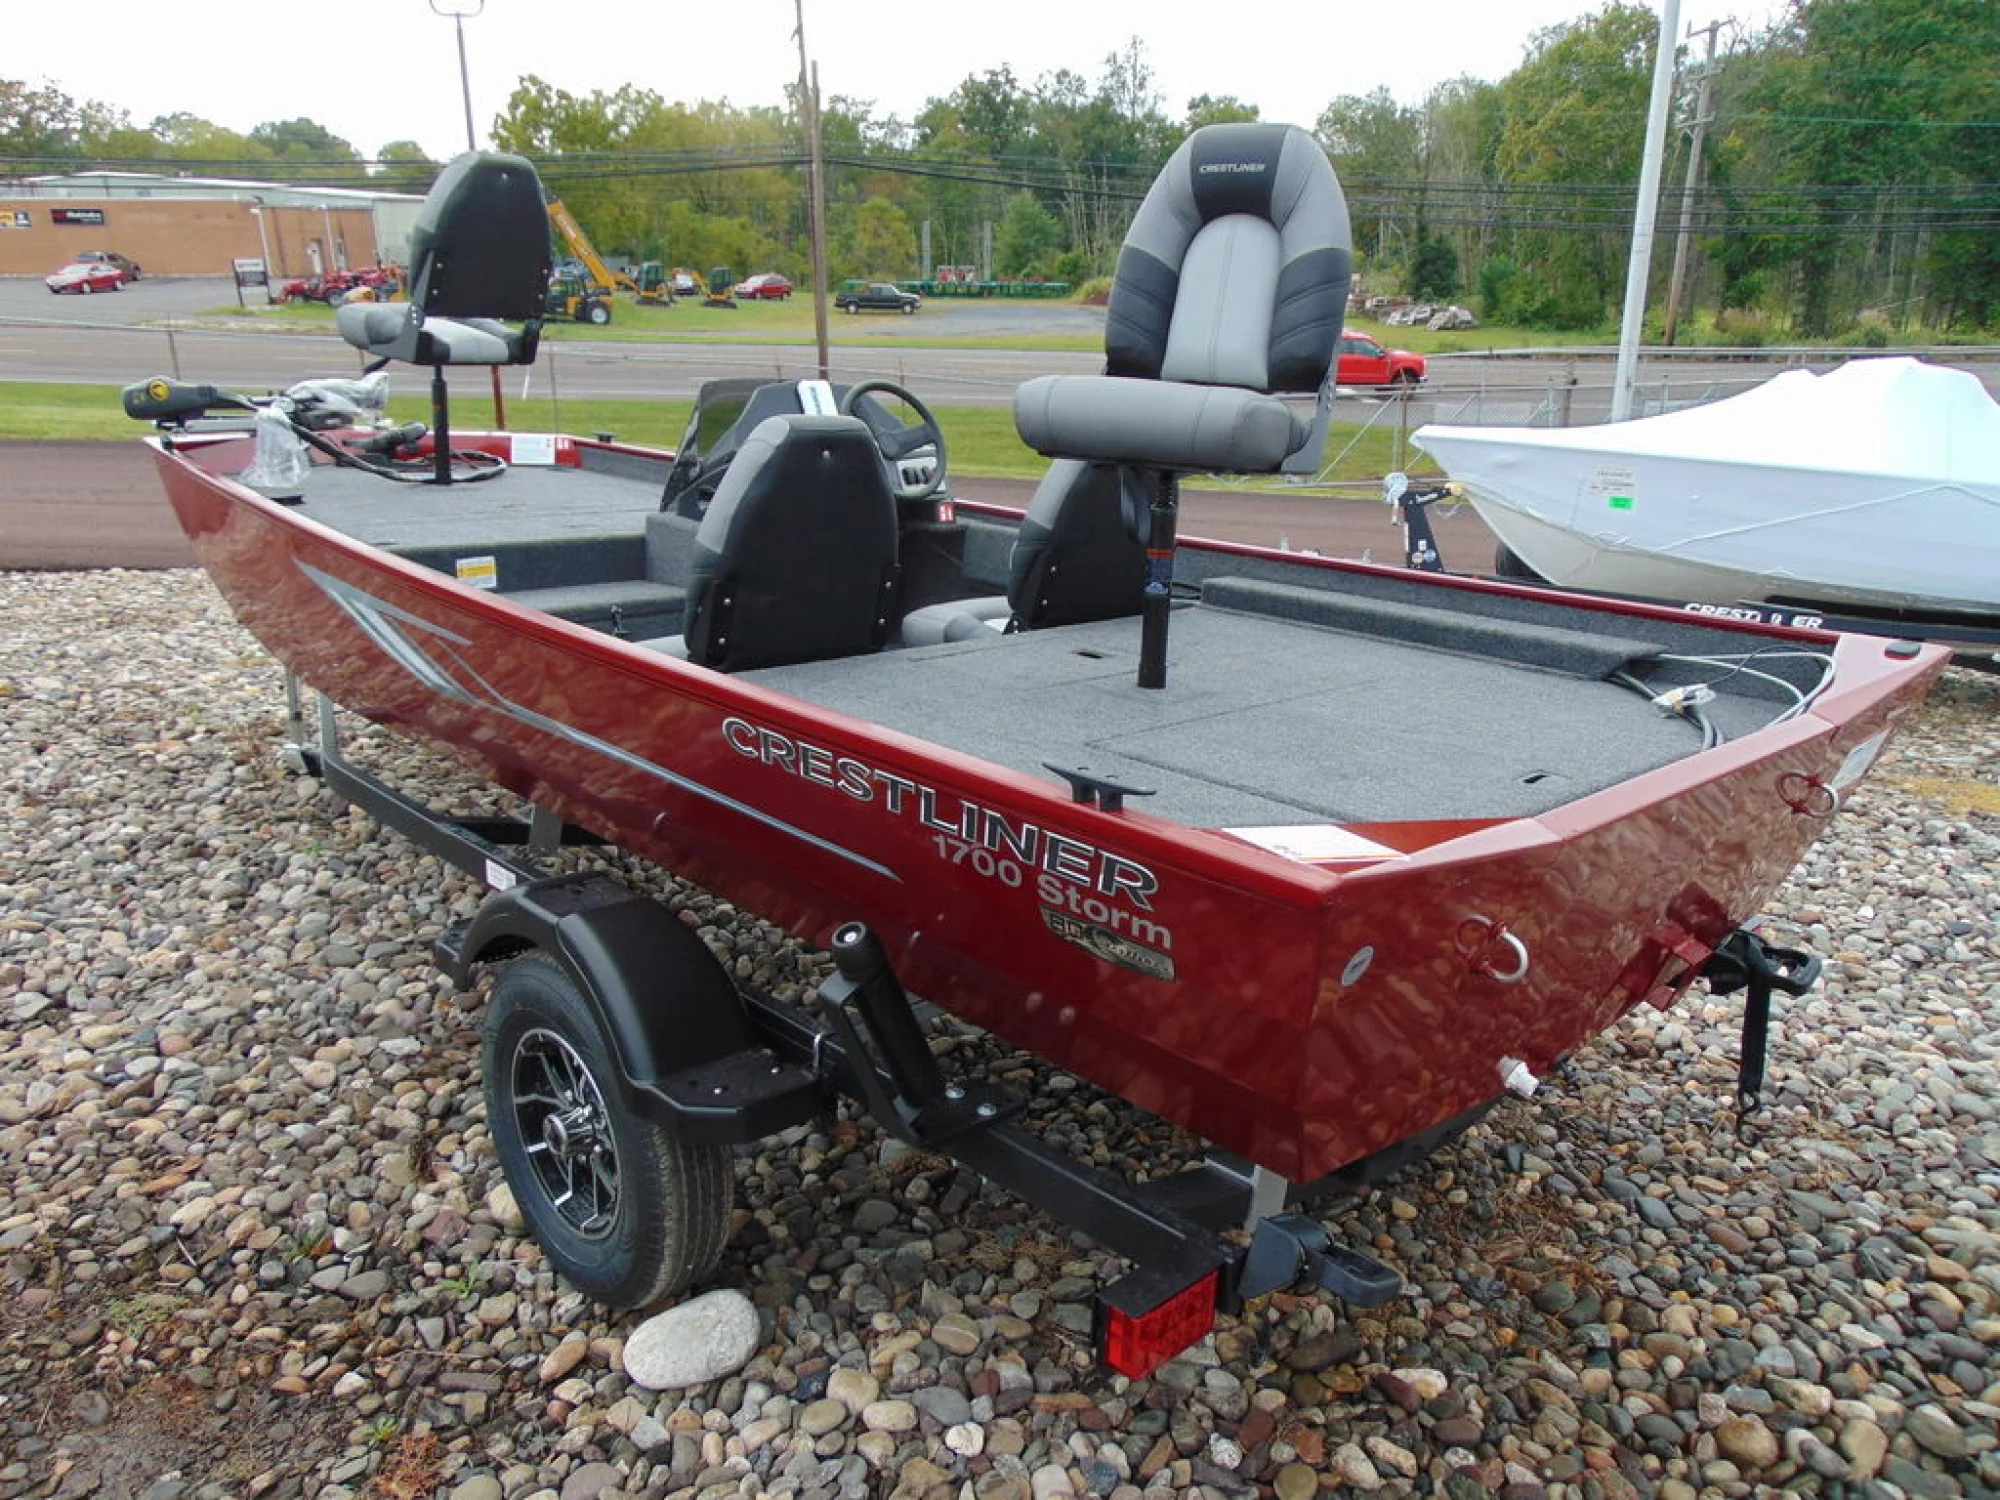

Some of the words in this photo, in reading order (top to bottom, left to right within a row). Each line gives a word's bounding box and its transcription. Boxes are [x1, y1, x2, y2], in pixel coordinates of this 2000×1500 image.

[1199, 163, 1266, 174] CRESTLINER
[722, 716, 1159, 912] CRESTLINER
[932, 834, 1023, 888] 1700
[1037, 873, 1173, 950] Storm
